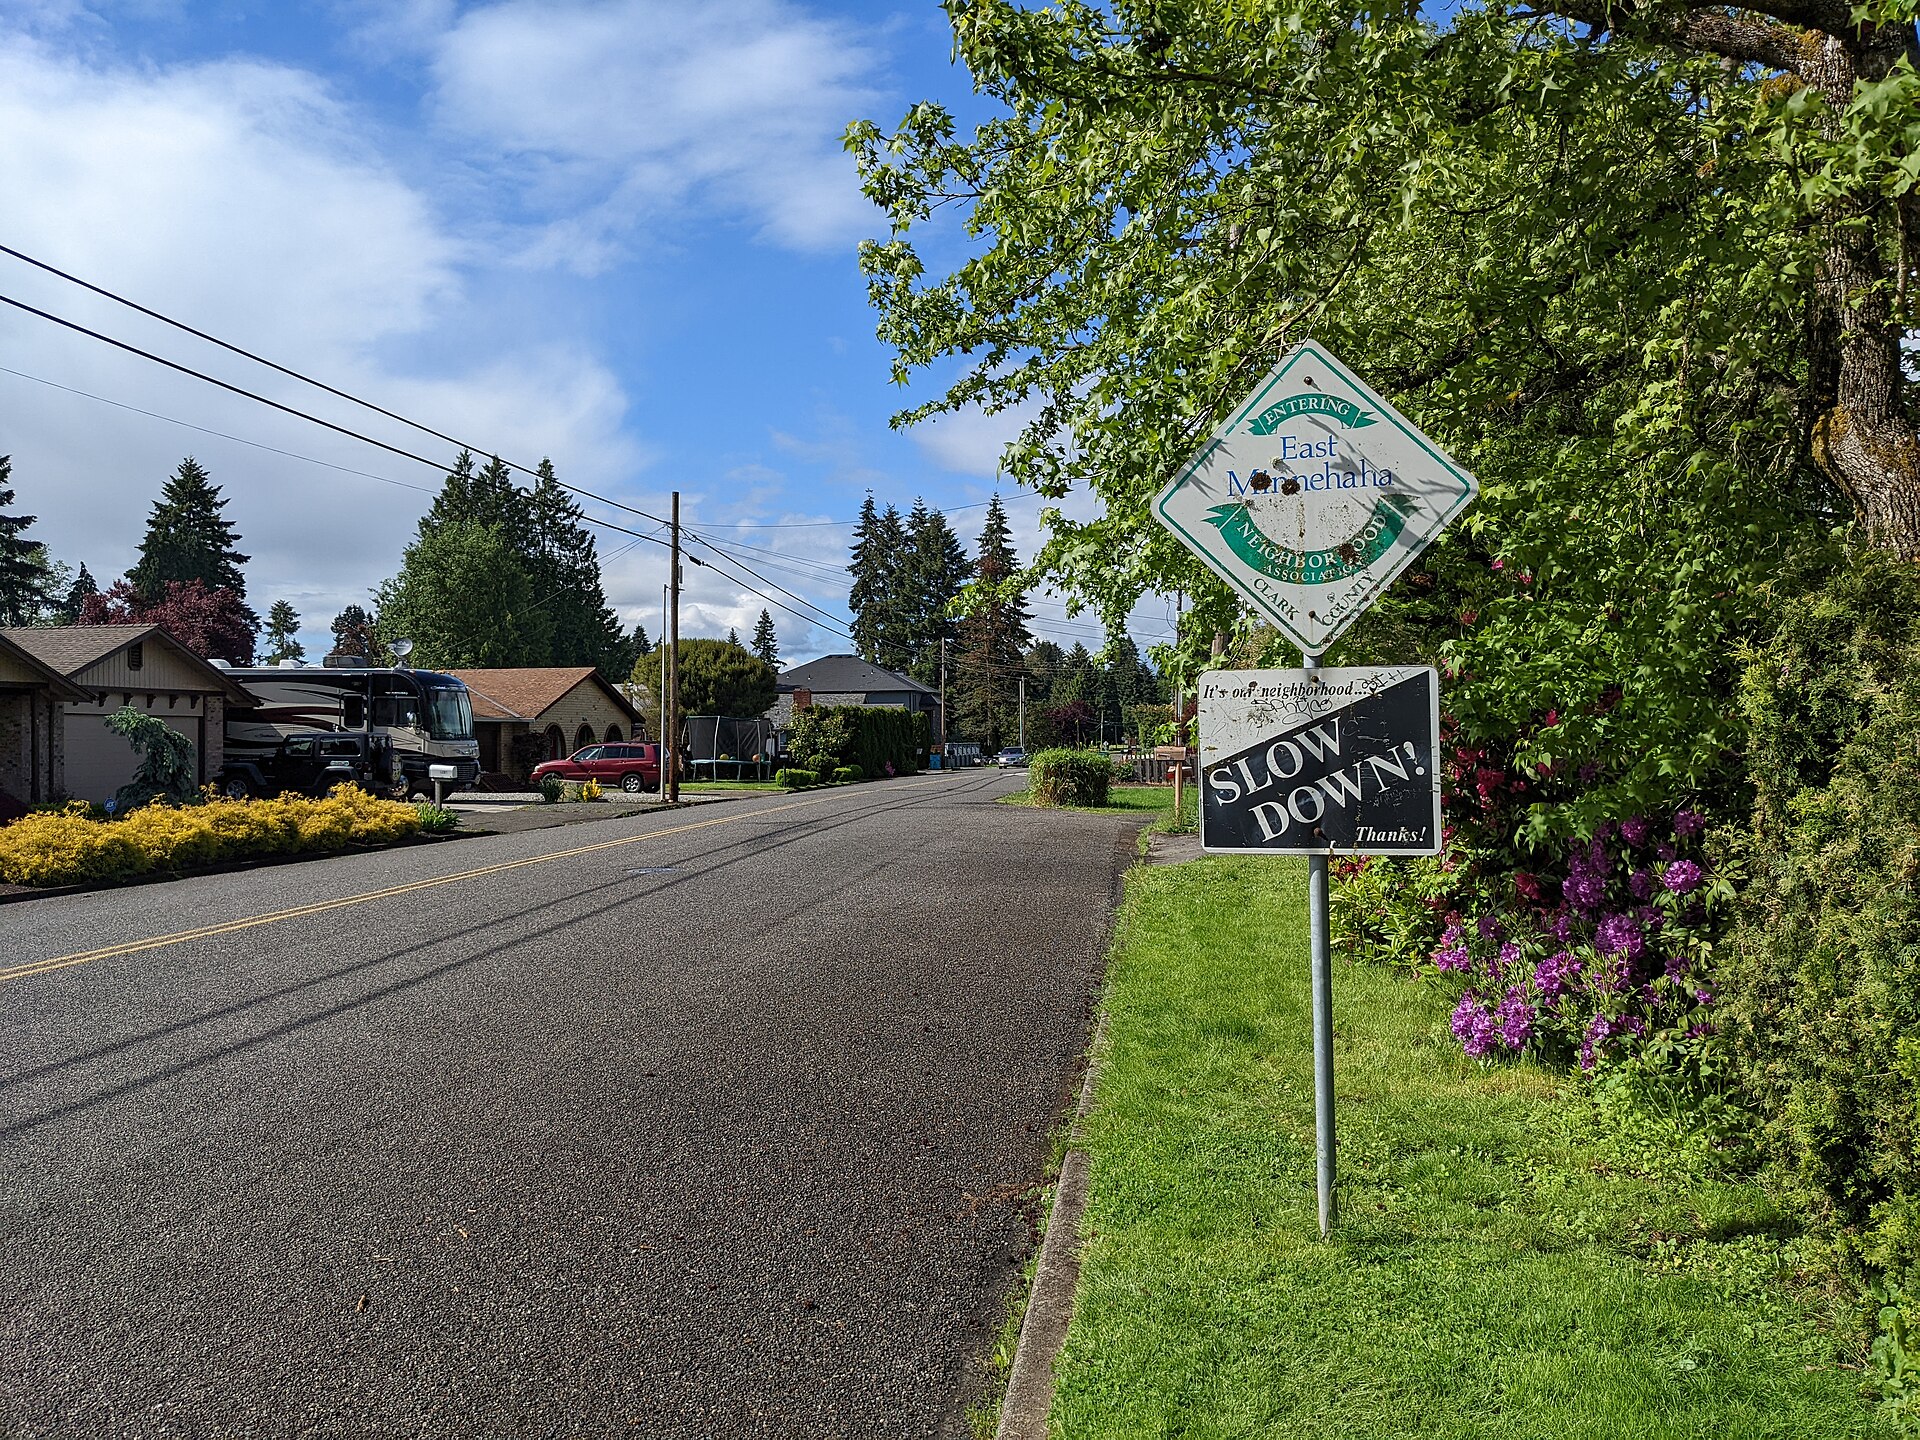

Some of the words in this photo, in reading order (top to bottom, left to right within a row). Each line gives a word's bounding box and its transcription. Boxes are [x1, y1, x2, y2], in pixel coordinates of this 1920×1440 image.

[1263, 397, 1351, 425] ENTERING
[1280, 434, 1338, 460] East
[1237, 513, 1386, 568] NEIGHBOROOD
[1264, 560, 1363, 582] ASSOCIATIO
[1253, 578, 1300, 621] CLARK
[1322, 571, 1377, 626] COUNTY
[1203, 684, 1229, 699] It's
[1232, 688, 1256, 698] our
[1261, 681, 1366, 699] neighborhood...
[1209, 716, 1342, 807] SLOW
[1248, 740, 1425, 843] DOWN!
[1355, 826, 1427, 843] Thanks!
